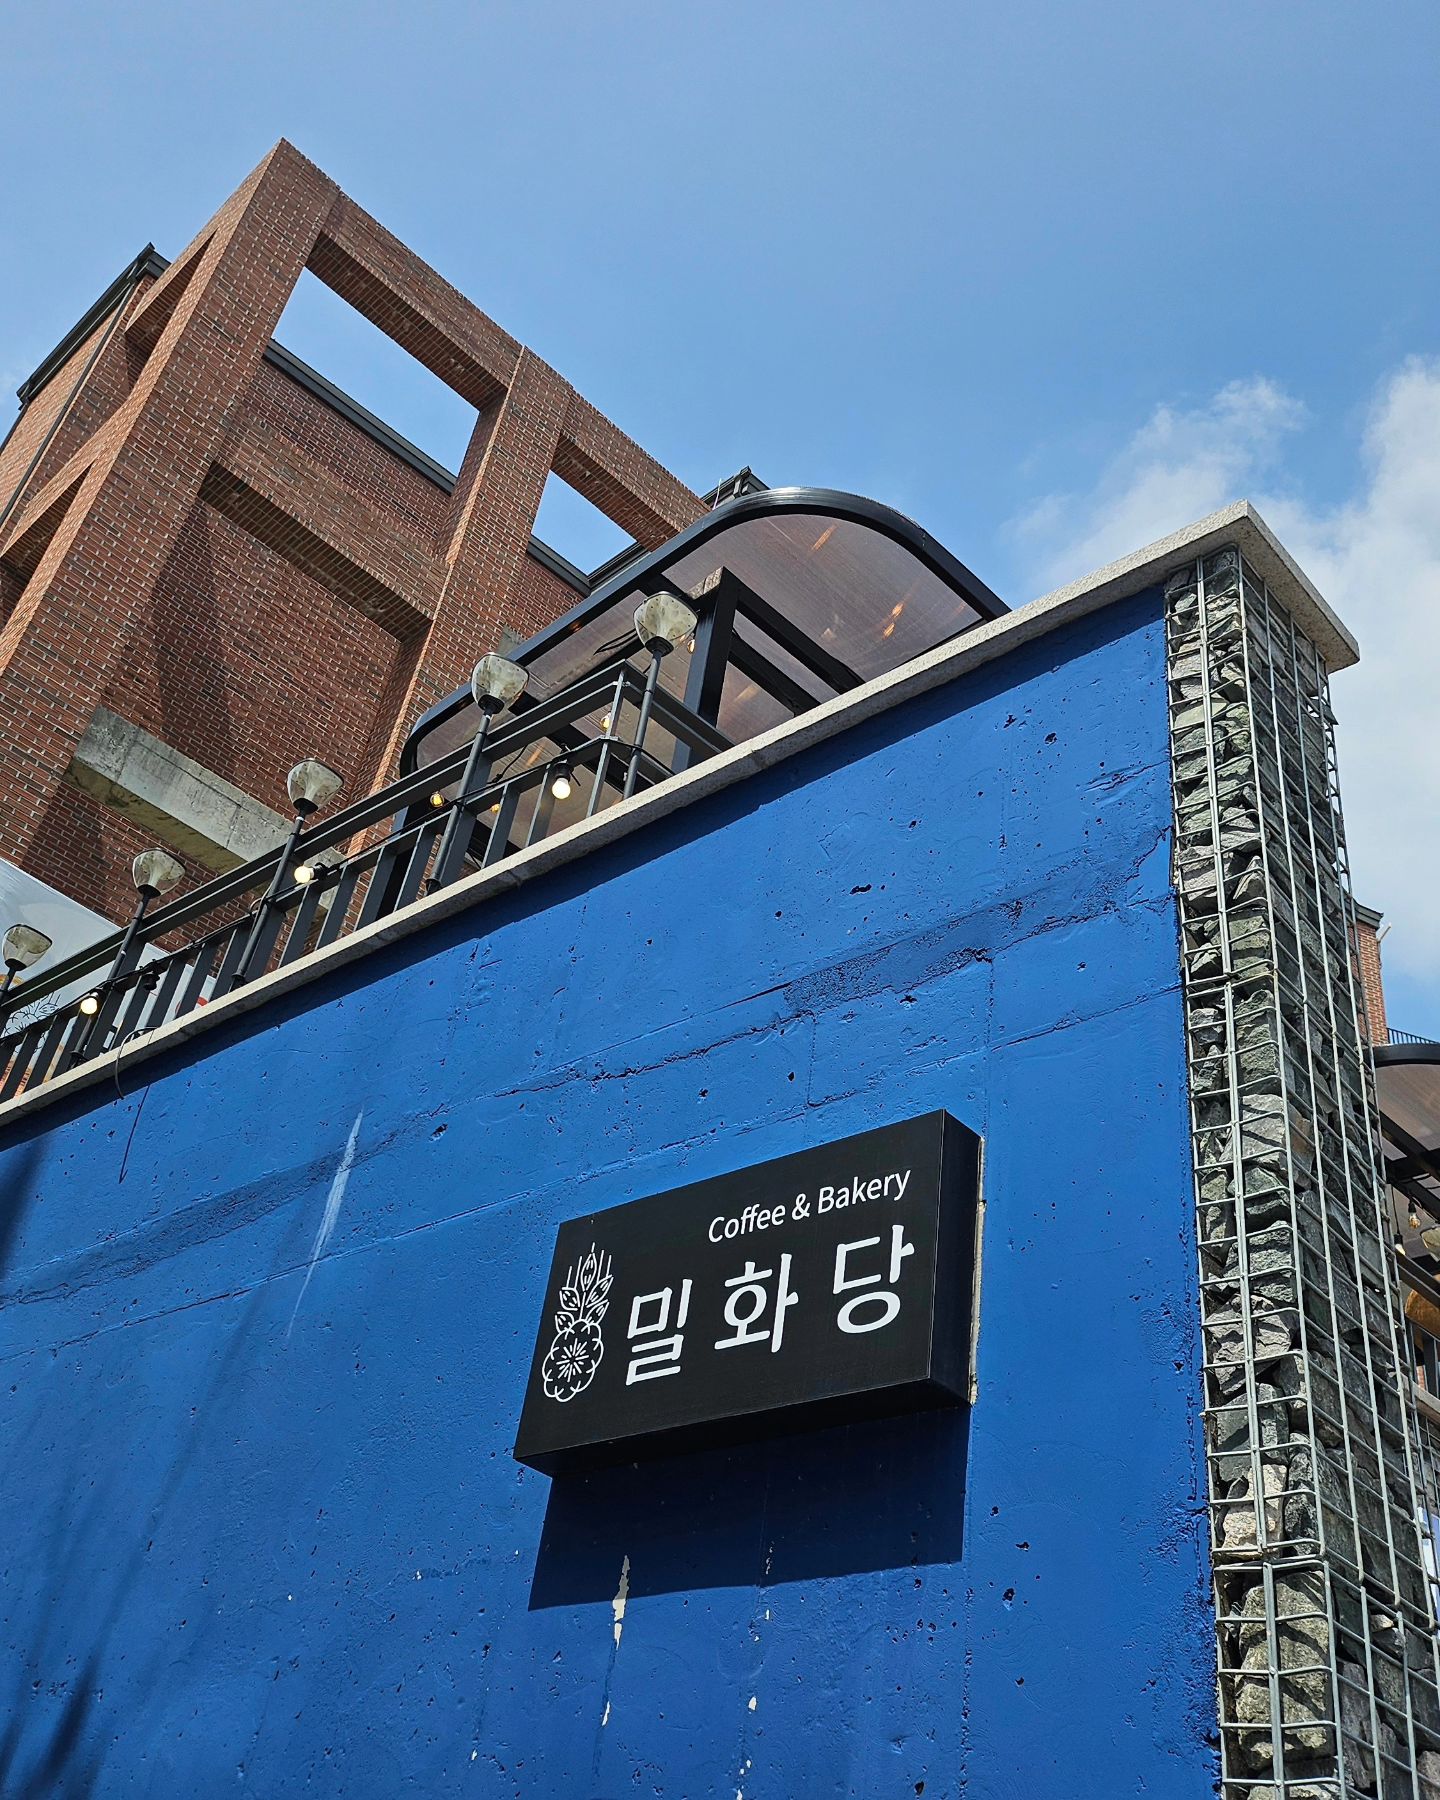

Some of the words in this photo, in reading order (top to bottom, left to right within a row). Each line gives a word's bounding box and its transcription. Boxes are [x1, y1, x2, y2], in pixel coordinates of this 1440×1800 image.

[709, 1204, 786, 1243] Coffee
[791, 1193, 811, 1221] &
[818, 1170, 912, 1214] Bakery
